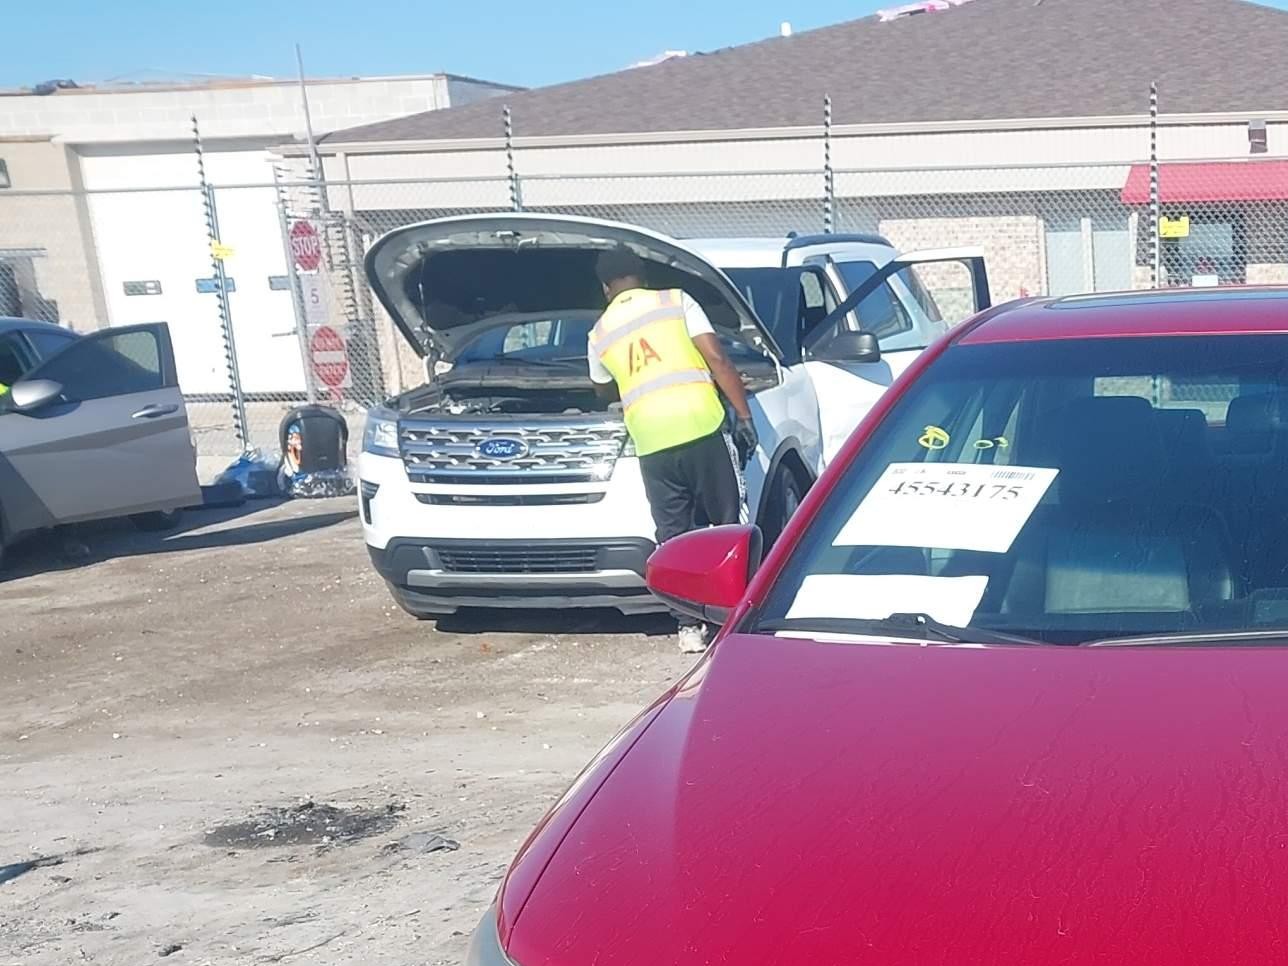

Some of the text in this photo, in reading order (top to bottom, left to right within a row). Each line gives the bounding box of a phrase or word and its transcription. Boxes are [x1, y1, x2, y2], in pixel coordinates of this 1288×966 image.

[292, 236, 319, 257] STOP
[310, 288, 320, 305] 5
[485, 442, 515, 454] Ford
[888, 481, 1024, 500] 45543175
